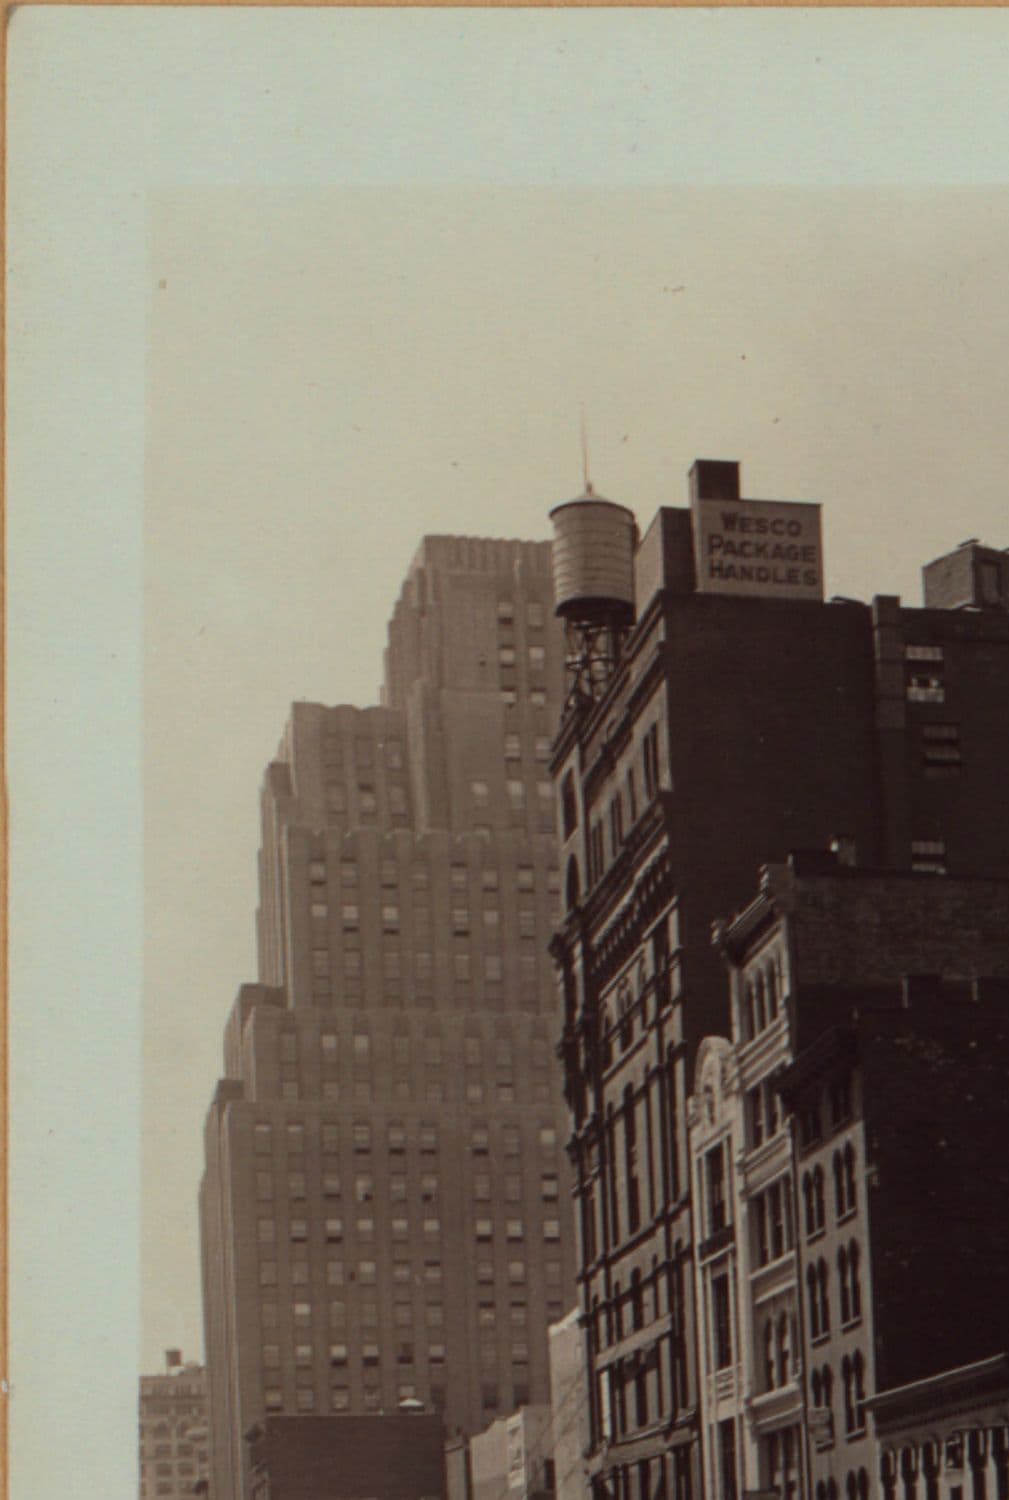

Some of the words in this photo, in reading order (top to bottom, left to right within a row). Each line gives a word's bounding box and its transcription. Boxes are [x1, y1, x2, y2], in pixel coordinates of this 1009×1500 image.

[720, 511, 802, 537] WESCO
[707, 533, 817, 563] PACKAGE
[709, 558, 818, 586] HANDLES
